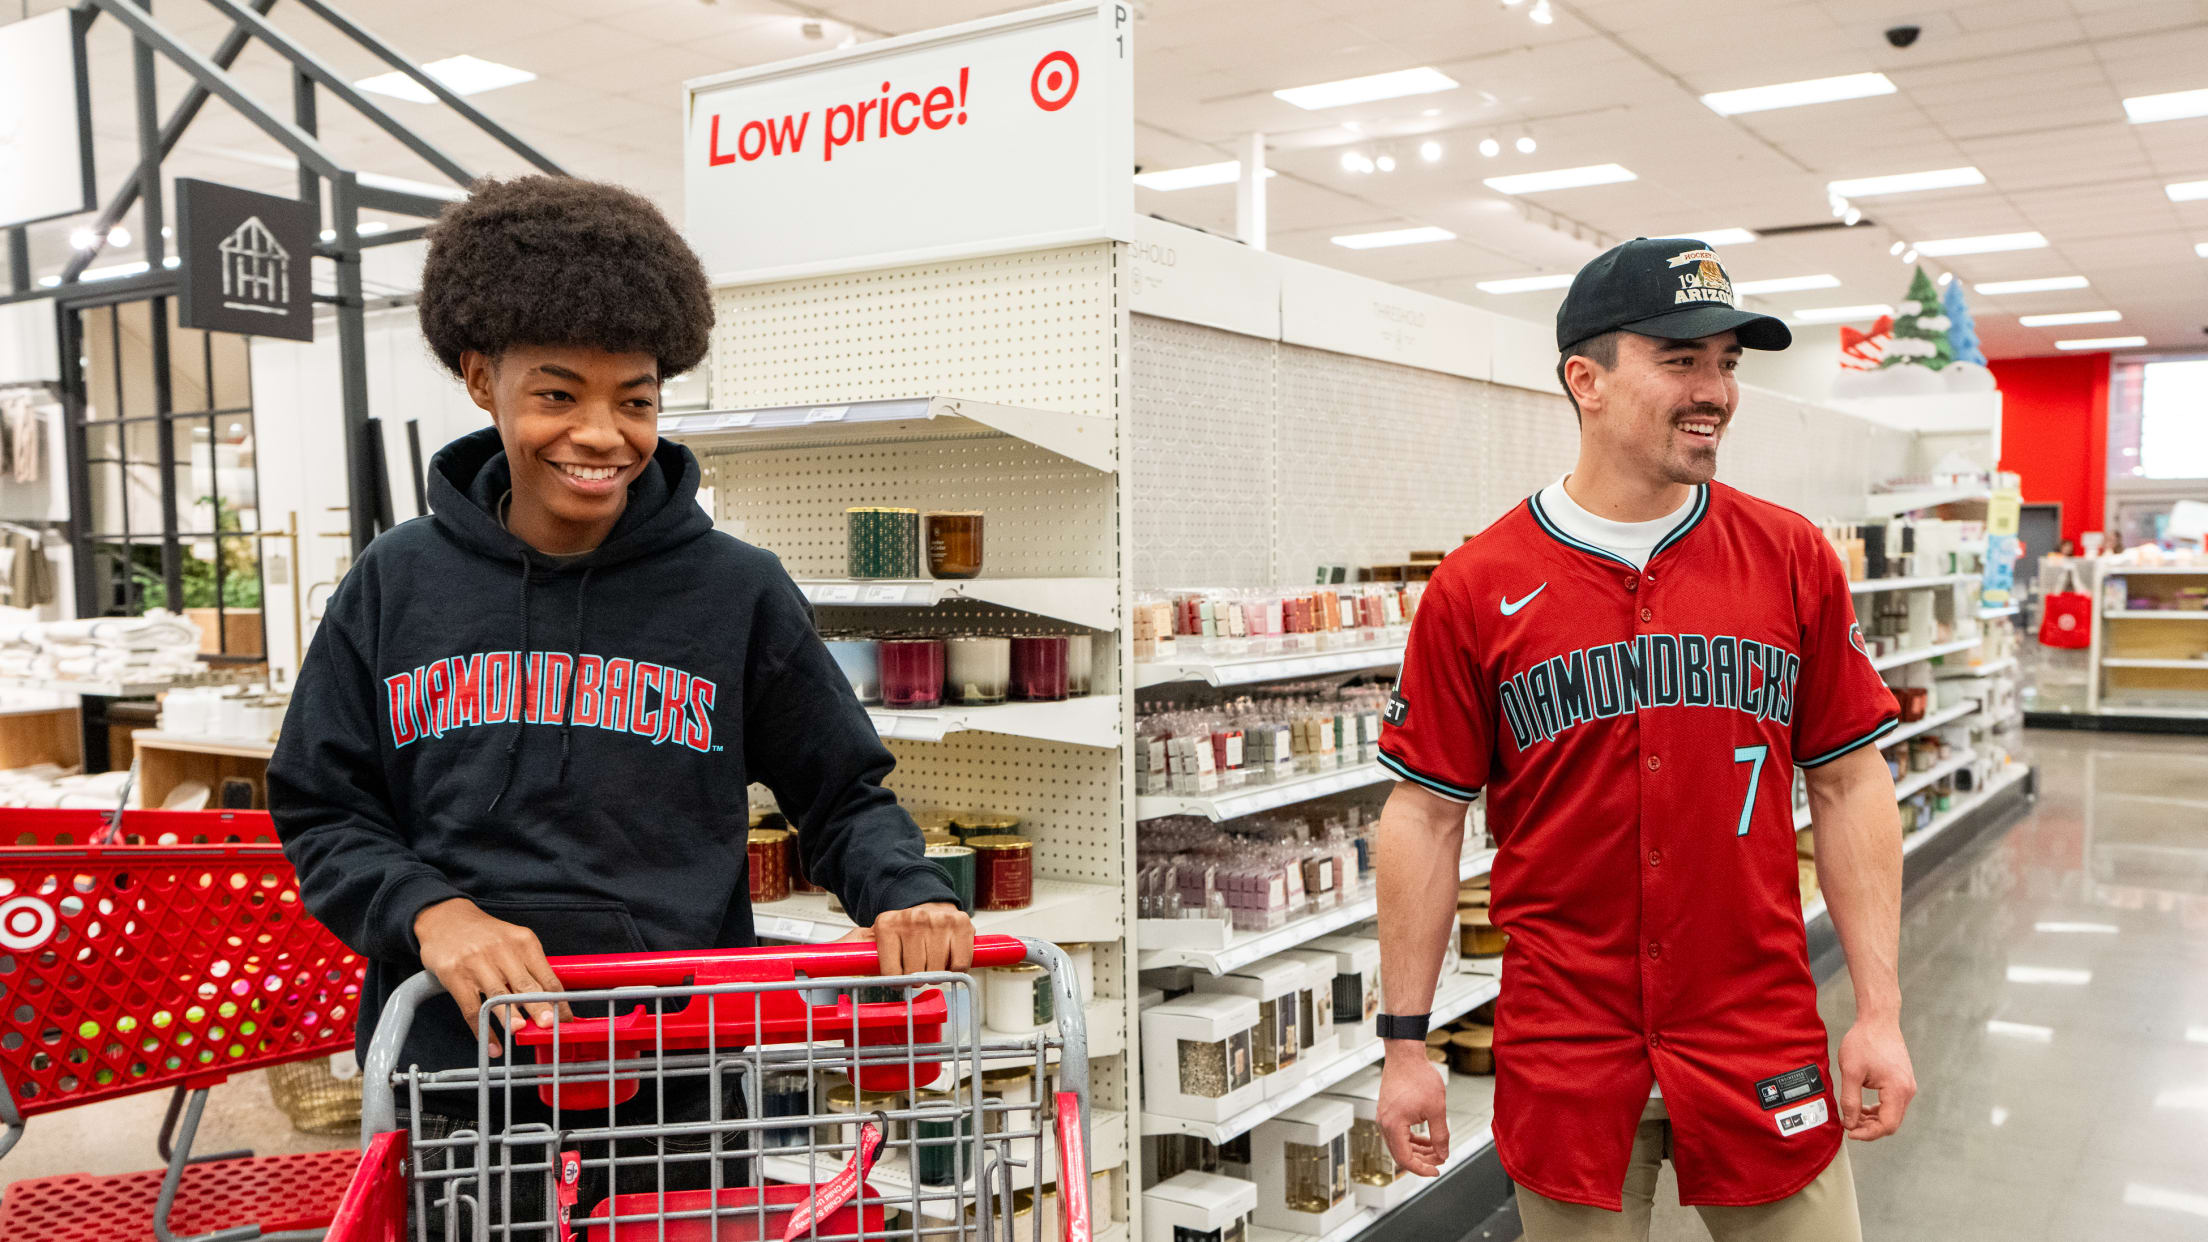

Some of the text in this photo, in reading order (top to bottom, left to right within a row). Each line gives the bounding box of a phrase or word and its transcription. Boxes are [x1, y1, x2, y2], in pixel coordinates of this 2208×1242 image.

[1115, 4, 1127, 29] P
[709, 66, 969, 167] Low price!
[1128, 240, 1176, 268] SHOLD
[1684, 252, 1712, 261] HOCKEY
[384, 651, 717, 753] DIAMONDBACKS
[1499, 634, 1800, 753] DIAMONDBACKS
[1384, 698, 1405, 721] ET
[1734, 745, 1769, 837] 7
[823, 1195, 842, 1213] Child
[824, 1184, 842, 1201] Child
